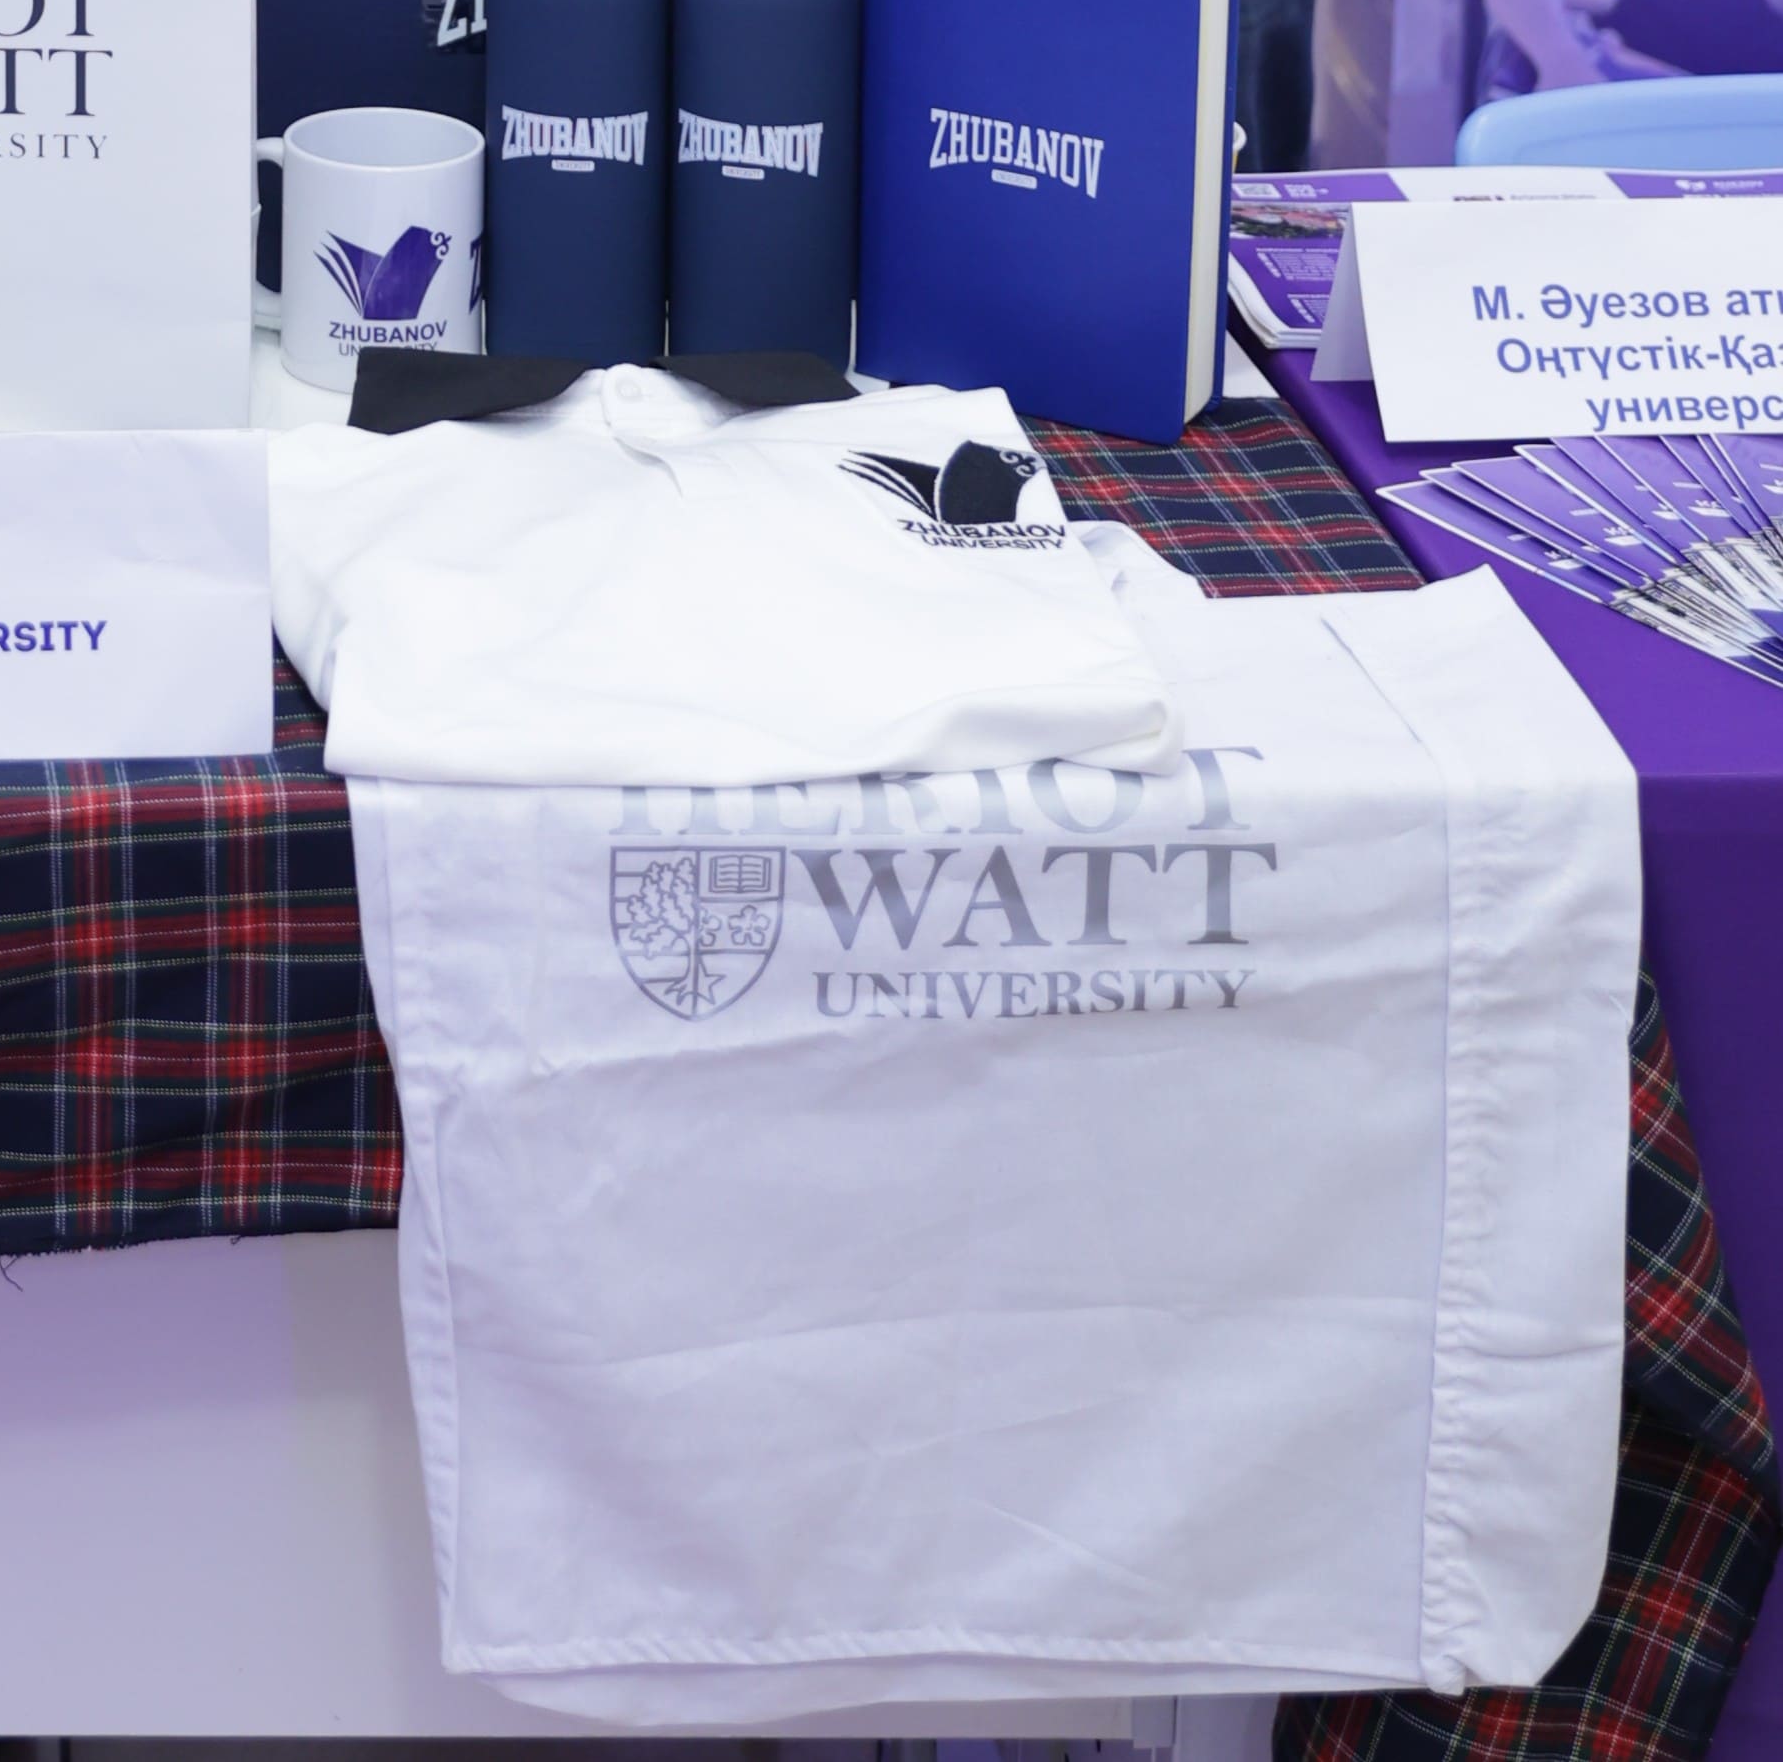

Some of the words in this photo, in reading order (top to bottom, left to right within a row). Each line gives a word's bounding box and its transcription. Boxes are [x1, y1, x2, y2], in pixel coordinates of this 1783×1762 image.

[502, 104, 649, 166] ZHUBANOV
[678, 107, 824, 178] ZHUBANOV
[929, 107, 1105, 199] ZHUBANOV
[328, 319, 448, 344] ZHUBANOV
[1471, 285, 1525, 321] М.
[1539, 283, 1711, 329] Әуезов
[896, 519, 1068, 540] ZHUBANOV
[921, 535, 1066, 550] UNIVERSITY
[790, 841, 1278, 951] WATT
[814, 968, 1259, 1019] UNIVERSITY
